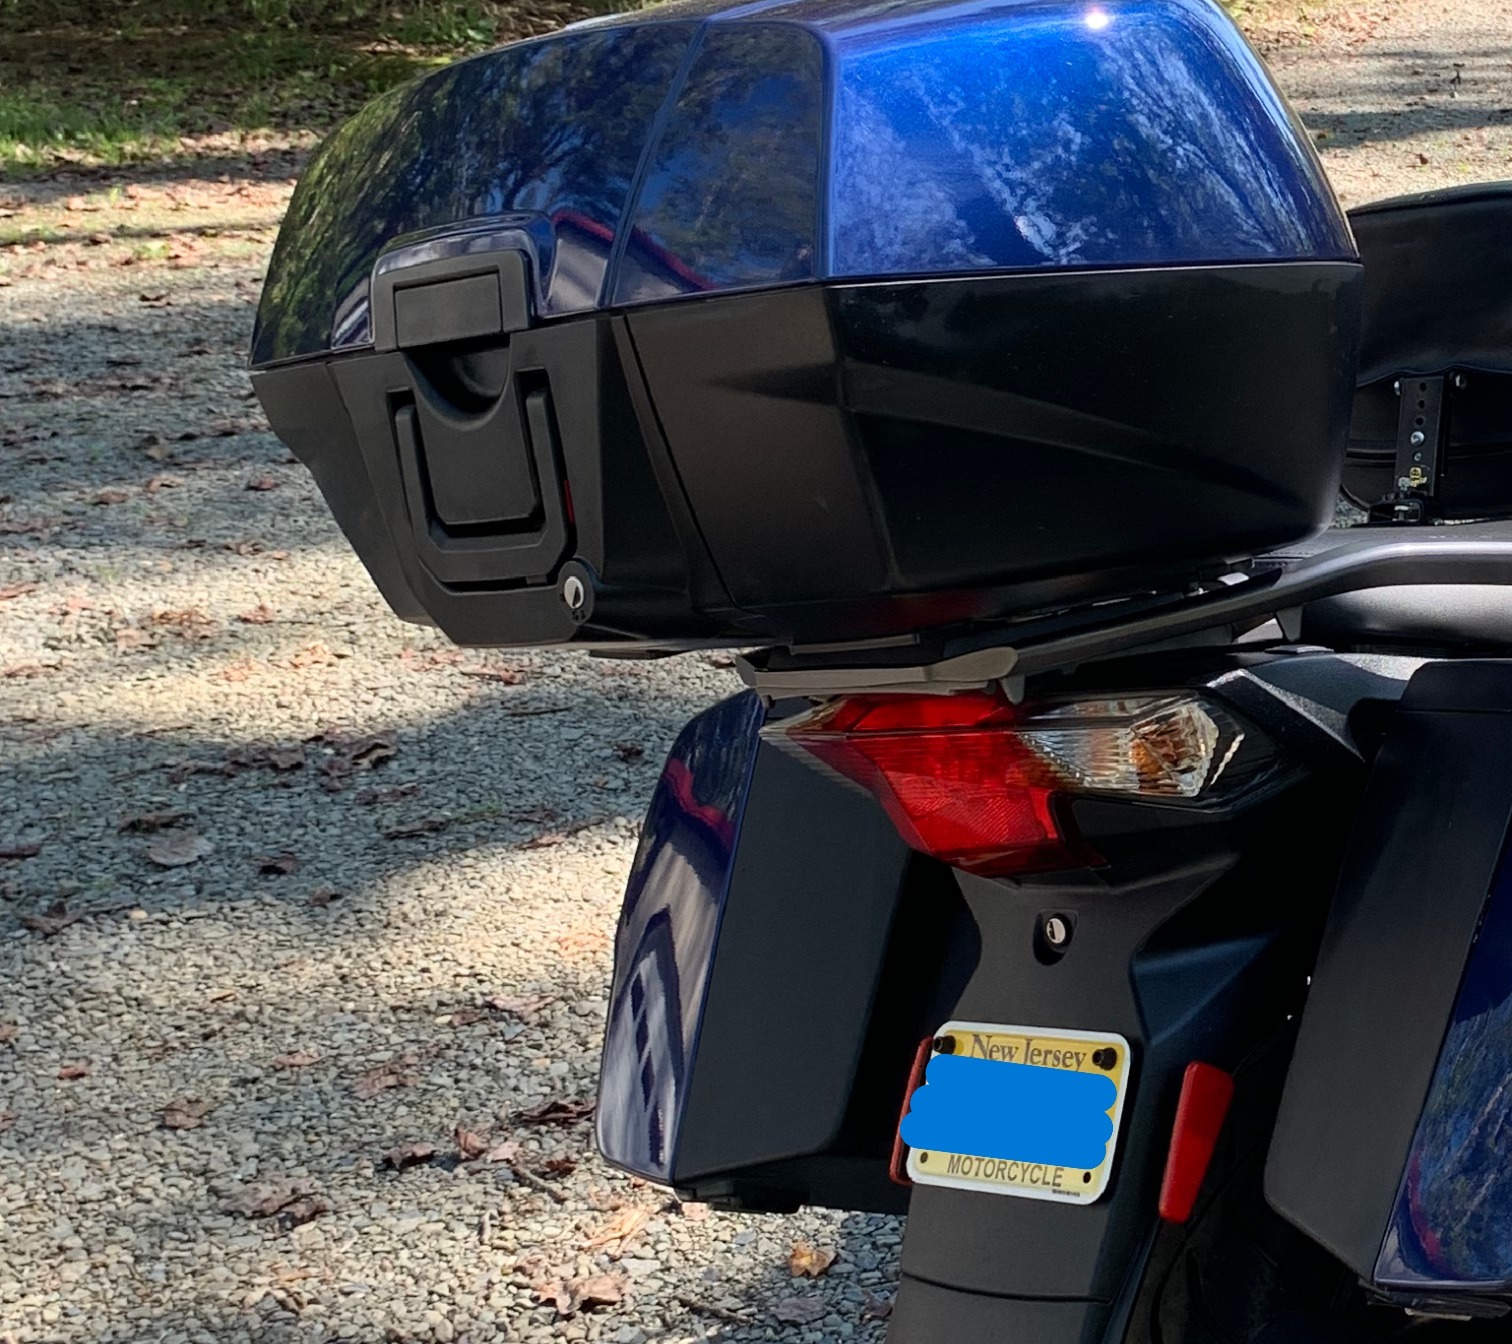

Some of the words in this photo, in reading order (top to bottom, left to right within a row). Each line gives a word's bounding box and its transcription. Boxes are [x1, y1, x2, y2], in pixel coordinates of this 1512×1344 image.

[971, 1033, 1019, 1062] New
[1022, 1037, 1088, 1072] Jersey
[946, 1154, 1065, 1188] MOTORCYCLE
